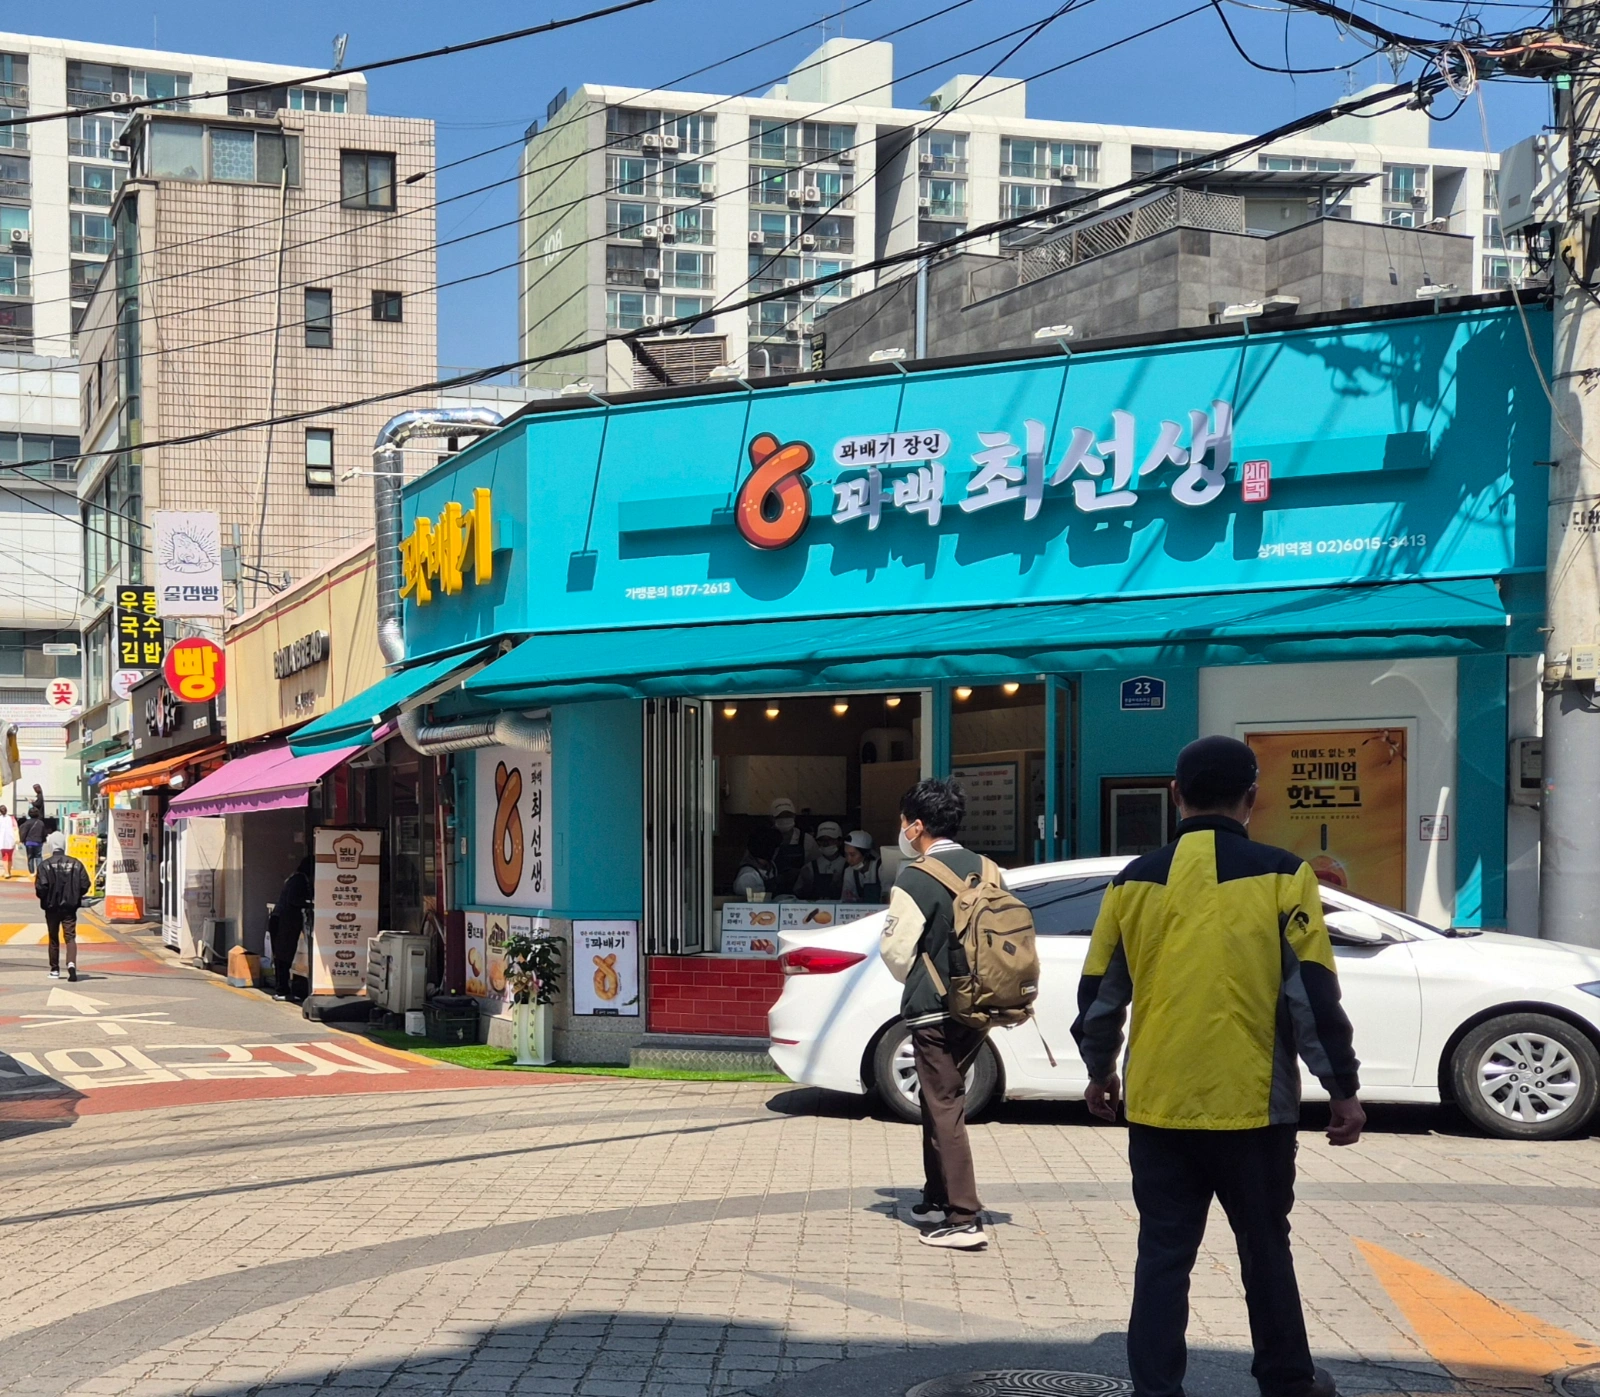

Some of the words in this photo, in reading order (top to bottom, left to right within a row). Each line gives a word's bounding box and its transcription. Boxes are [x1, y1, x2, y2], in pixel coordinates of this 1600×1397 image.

[839, 437, 895, 460] 꽈배기
[903, 433, 940, 456] 장인
[832, 461, 945, 530] 꽈백
[958, 399, 1234, 521] 최선생
[398, 486, 492, 607] 꽈배기
[1258, 540, 1312, 558] 상계역점
[1316, 534, 1427, 554] 02)6015-3413
[670, 582, 731, 597] 1877-2613
[119, 591, 157, 615] 우동
[120, 616, 162, 640] 국수
[121, 642, 162, 665] 김밥
[173, 645, 218, 699] 빵
[52, 682, 73, 705] 꽃
[1134, 682, 1151, 695] 23
[1291, 748, 1326, 759] 어디에도
[1328, 748, 1345, 758] 없는
[1291, 762, 1357, 781] 프리미엄
[1287, 785, 1362, 809] 핫도그
[118, 828, 136, 838] 김밥
[530, 787, 542, 894] 최선생
[339, 847, 357, 856] 보나
[590, 936, 625, 950] 꽈배기
